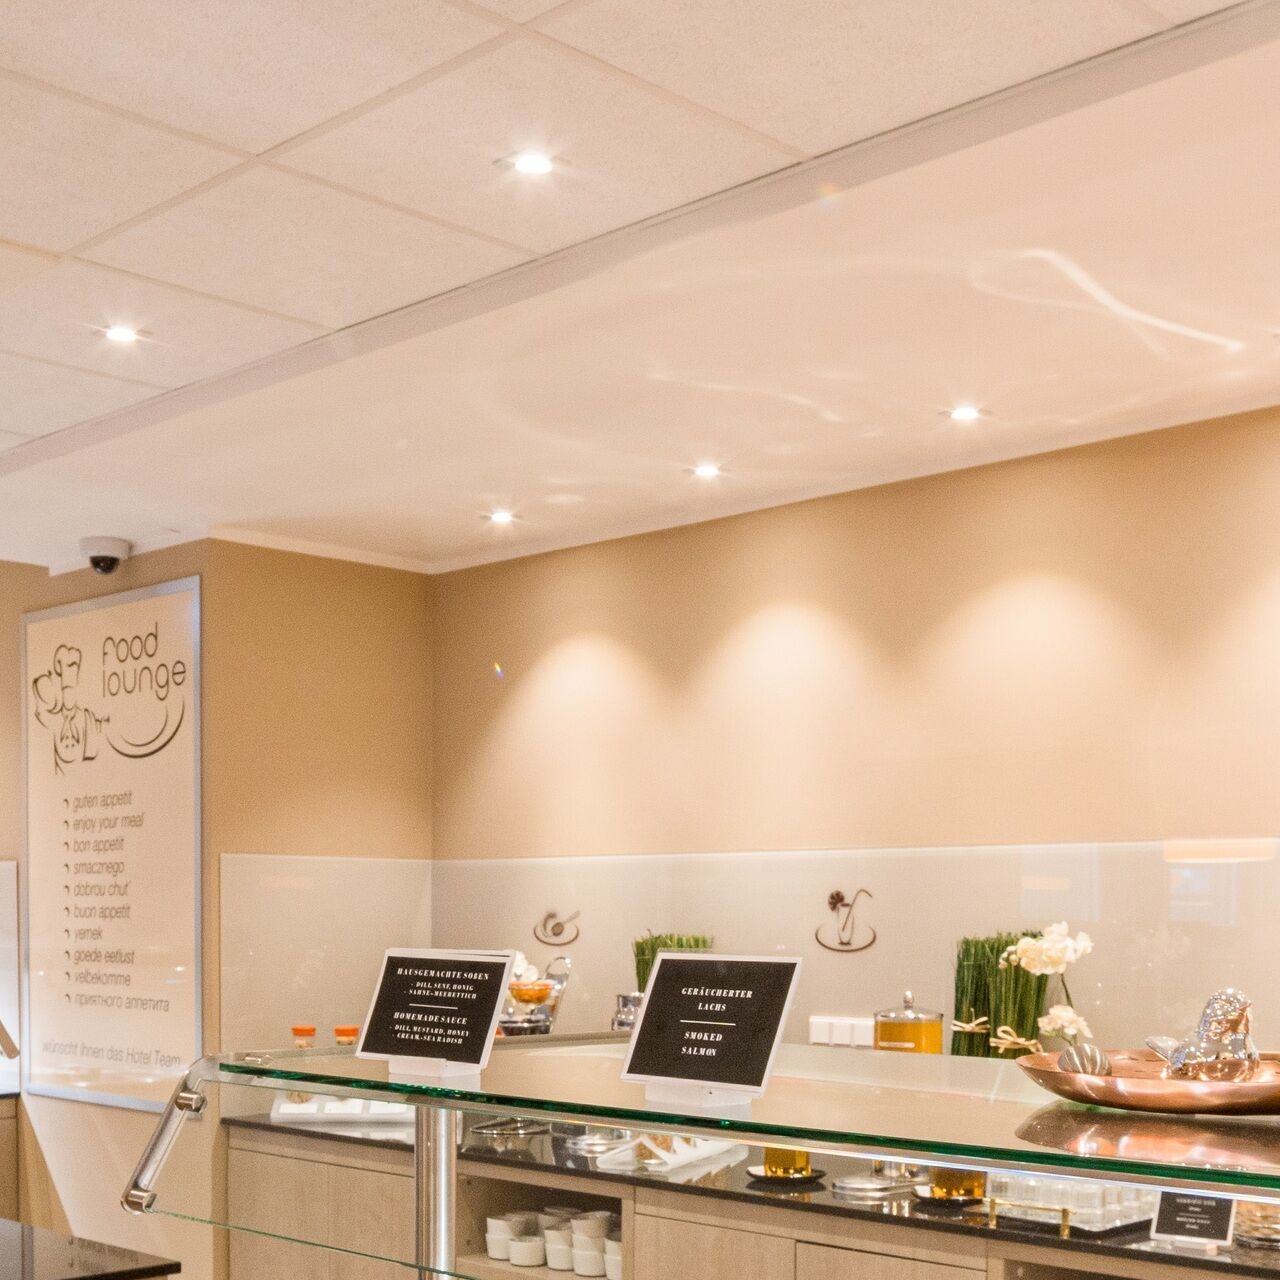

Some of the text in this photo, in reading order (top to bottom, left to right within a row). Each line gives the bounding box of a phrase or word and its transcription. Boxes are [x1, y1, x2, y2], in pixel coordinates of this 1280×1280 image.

[103, 621, 158, 666] food
[103, 660, 186, 701] lounge
[73, 789, 132, 813] guten appetit
[73, 812, 144, 833] enjoy your meal
[73, 839, 90, 853] bon
[73, 861, 124, 877] smacznego
[73, 882, 105, 896] dobrou
[73, 902, 130, 920] buon appetit
[74, 948, 102, 965] goede
[397, 968, 462, 979] HAUSGEMACHTE
[681, 986, 753, 998] GERÄUCHERTER
[698, 1002, 727, 1012] LACHS
[393, 1012, 468, 1025] HOMEMADE SAUCE
[447, 1029, 469, 1037] HONEY
[684, 1031, 723, 1042] SMOKED
[106, 1044, 124, 1062] das
[126, 1047, 152, 1065] Hotel
[154, 1050, 181, 1068] Team
[681, 1046, 717, 1057] SALMON
